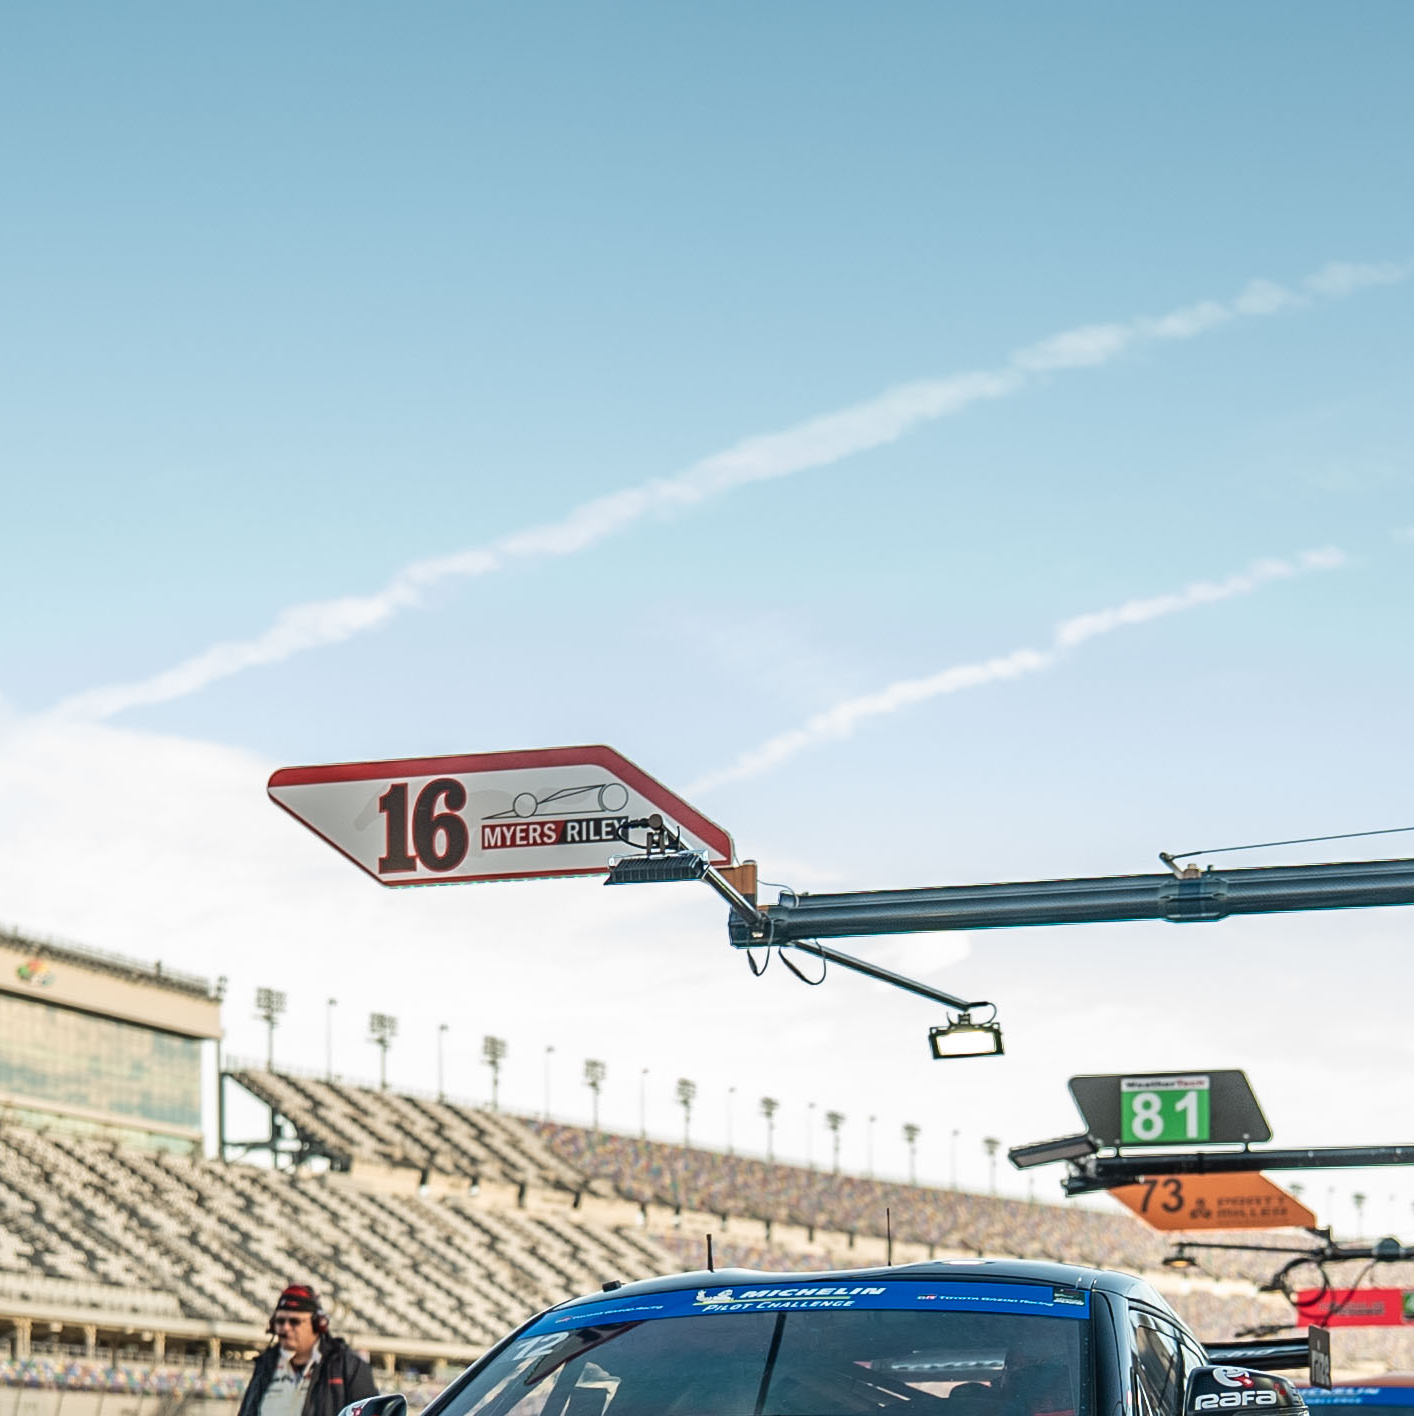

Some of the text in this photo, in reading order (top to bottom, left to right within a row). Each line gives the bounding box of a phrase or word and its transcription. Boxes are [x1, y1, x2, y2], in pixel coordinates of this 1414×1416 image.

[378, 777, 469, 875] 16
[483, 818, 627, 848] MYERS RILEY
[1131, 1090, 1201, 1141] 81
[1141, 1178, 1185, 1214] 73
[702, 1299, 856, 1312] PILOT CHALLENGE
[739, 1287, 887, 1299] MICHELIN
[512, 1331, 571, 1361] 12
